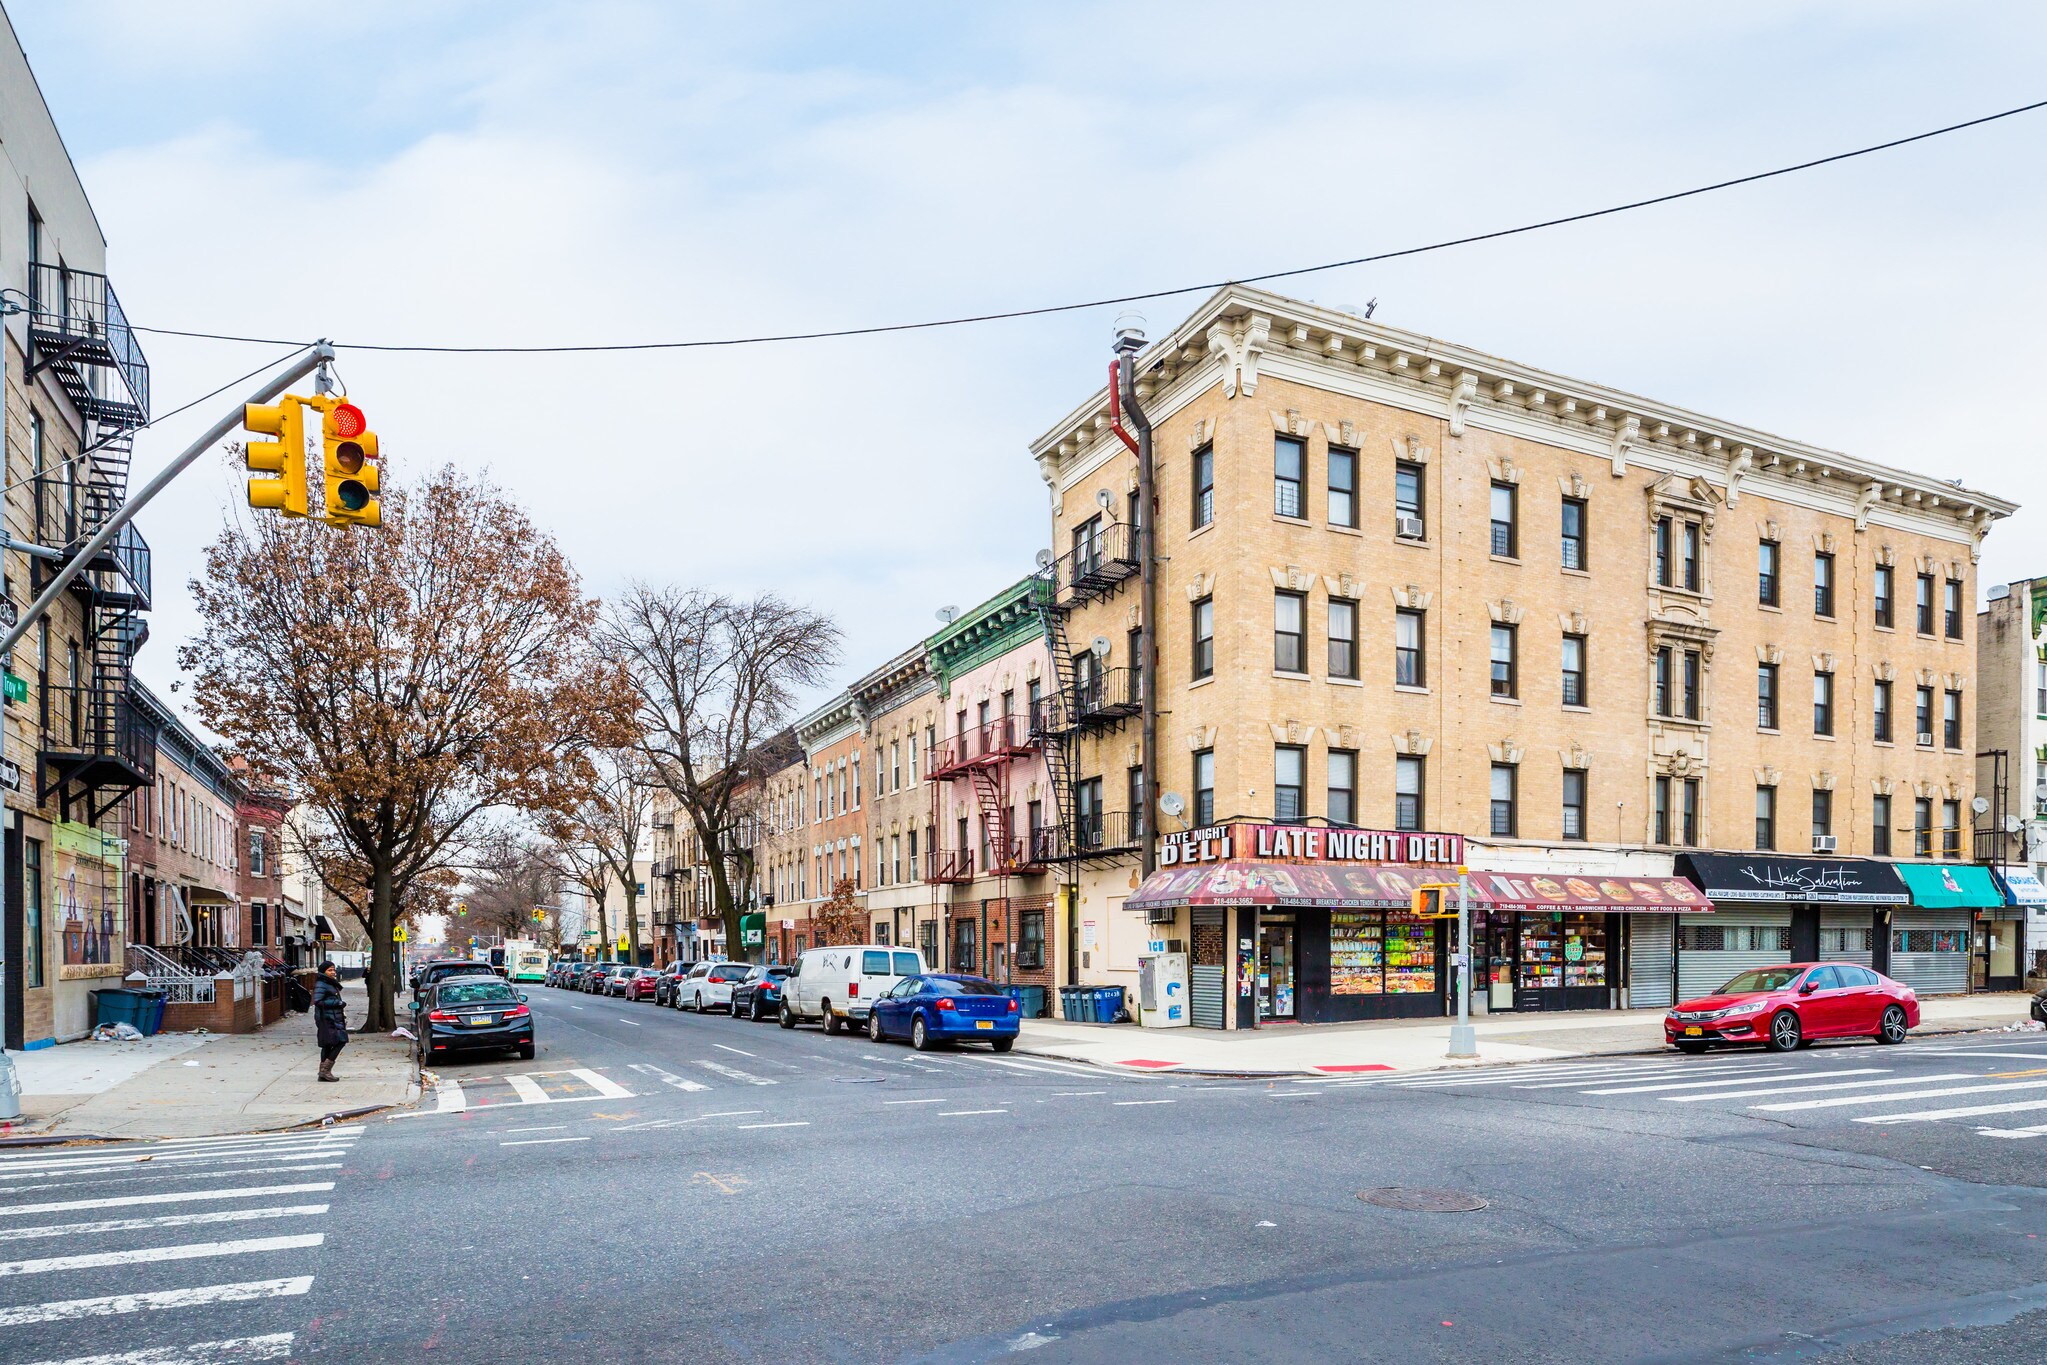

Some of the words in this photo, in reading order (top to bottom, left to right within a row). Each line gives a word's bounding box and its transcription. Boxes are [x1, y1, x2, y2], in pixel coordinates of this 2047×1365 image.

[3, 674, 17, 699] Troy
[1164, 831, 1189, 846] LATE
[1194, 825, 1227, 842] NIGHT
[1258, 829, 1319, 858] LATE
[1328, 832, 1400, 861] NIGHT
[1408, 836, 1458, 863] DELI
[1161, 836, 1230, 866] DELI
[1315, 898, 1339, 906] BREAKFAST
[1341, 899, 1360, 907] CHICKEN
[1148, 940, 1165, 953] ICE
